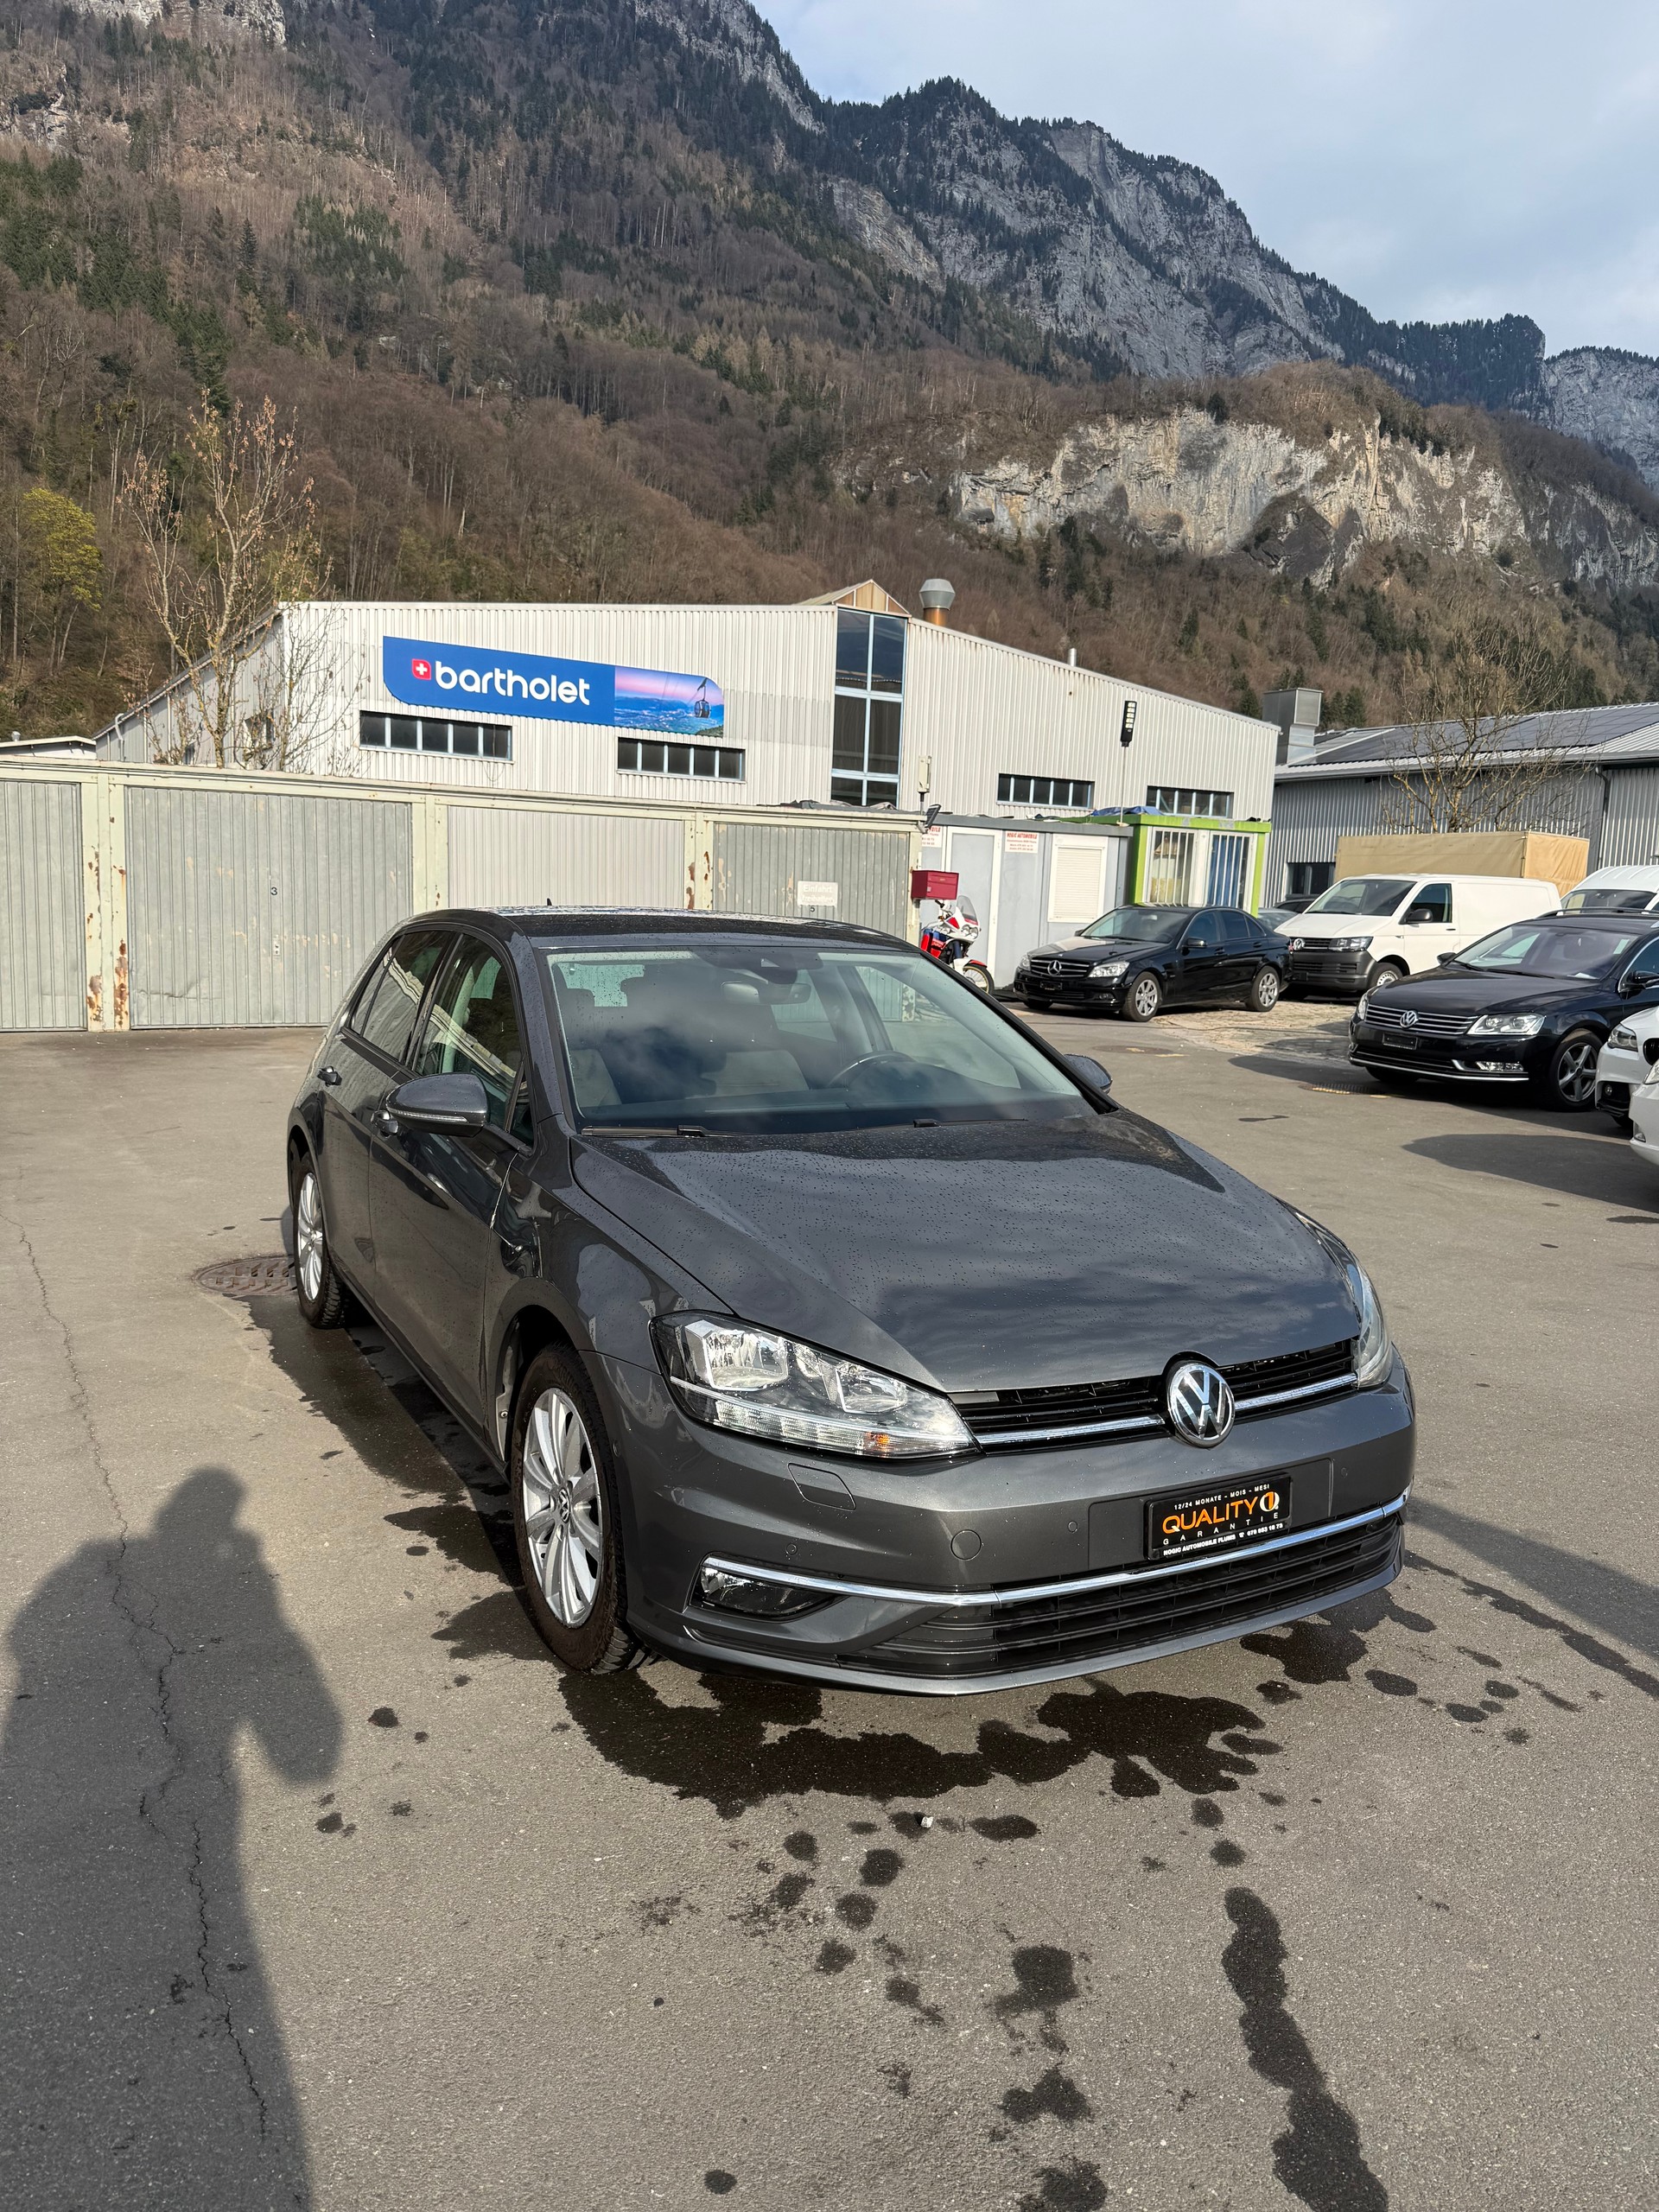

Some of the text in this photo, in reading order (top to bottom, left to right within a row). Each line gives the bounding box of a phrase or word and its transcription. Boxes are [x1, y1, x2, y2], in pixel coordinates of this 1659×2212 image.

[435, 660, 590, 705] bartholet
[270, 887, 277, 895] 3
[1174, 1501, 1192, 1510] 12/24
[1195, 1494, 1222, 1506] MONATE
[1230, 1489, 1246, 1498] MOIS
[1254, 1484, 1270, 1492] MESI
[1162, 1497, 1259, 1535] QUALITY
[1163, 1512, 1279, 1545] GARANTIE
[1182, 1538, 1217, 1552] AUTOMOBILE
